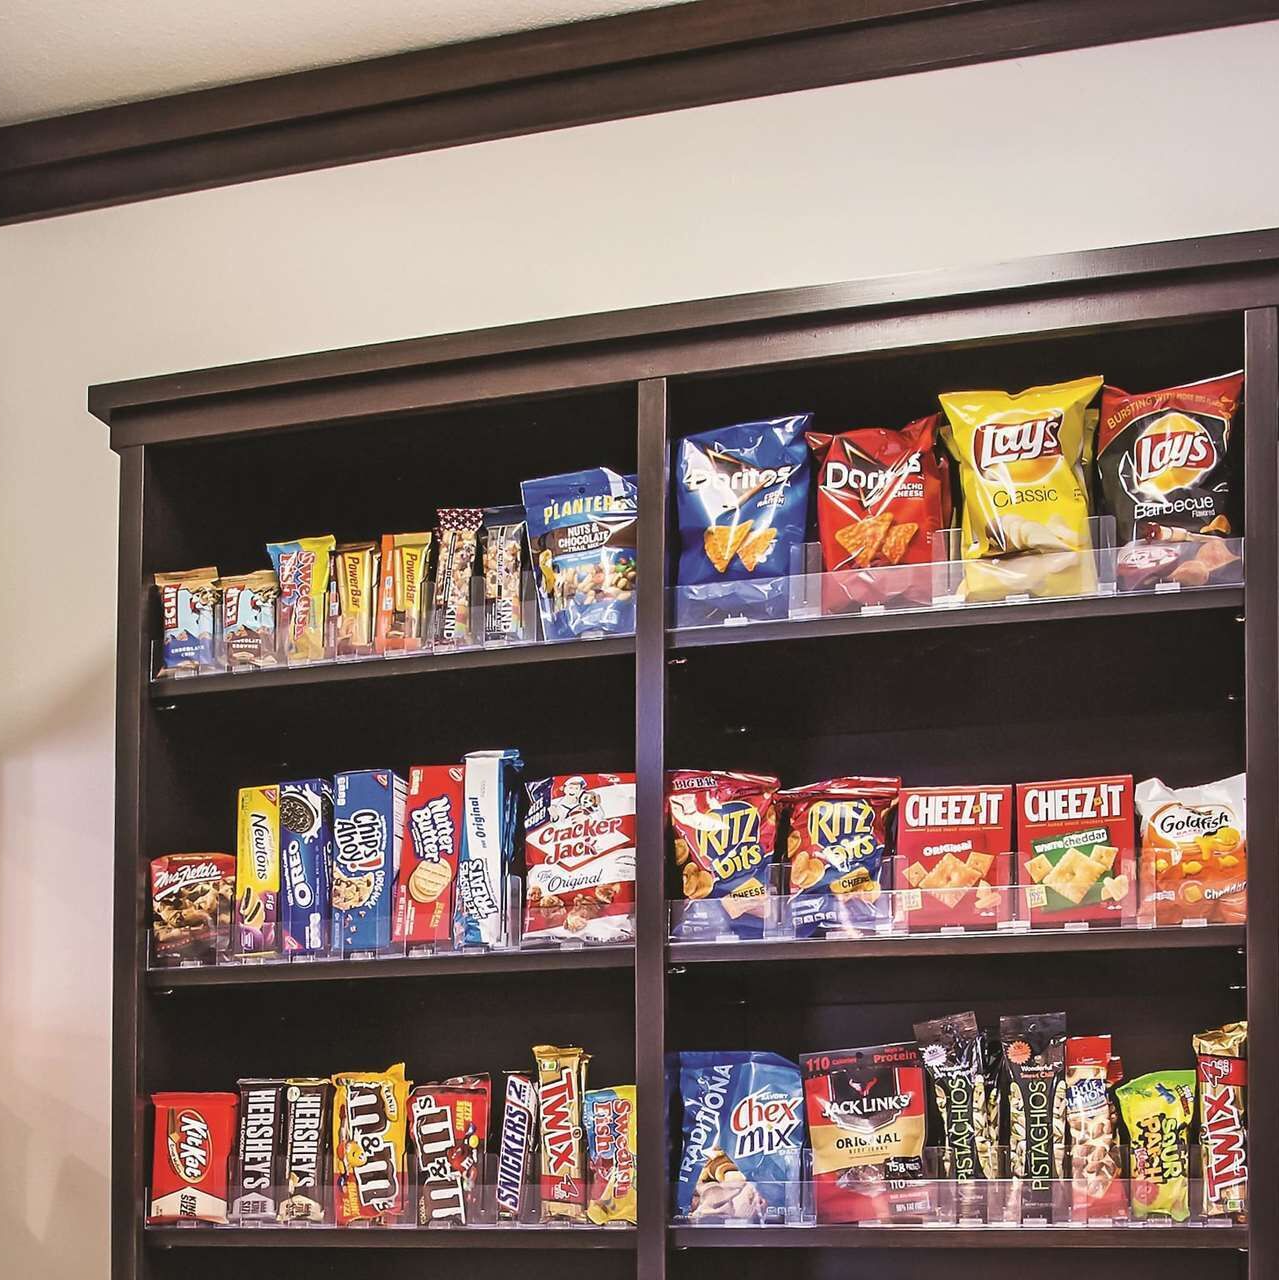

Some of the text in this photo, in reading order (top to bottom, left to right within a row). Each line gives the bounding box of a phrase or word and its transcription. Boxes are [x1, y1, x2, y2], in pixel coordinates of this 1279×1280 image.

[980, 418, 1060, 471] Lay's
[1139, 432, 1210, 482] Lay's
[689, 465, 792, 490] Doritos
[992, 485, 1059, 509] Classic
[1133, 495, 1214, 520] Barbecue
[558, 531, 609, 548] CHOCOLATE
[567, 522, 600, 538] NUTS &
[347, 556, 362, 608] PowerBar
[405, 550, 418, 605] PowerBar
[443, 605, 457, 640] KIND
[500, 599, 513, 632] KIND
[674, 776, 717, 790] BIG BAG
[352, 810, 379, 862] Chips
[411, 807, 441, 864] Butter
[428, 796, 455, 855] Nutter
[473, 796, 487, 839] Original
[537, 818, 623, 847] Cracker
[695, 806, 760, 857] RITZ
[809, 799, 874, 845] RITZ
[1160, 811, 1232, 836] Goldfish
[251, 813, 268, 881] Newtons
[545, 838, 599, 866] Jack
[711, 843, 762, 881] bits
[287, 840, 314, 909] OREO
[468, 858, 499, 920] TREATS
[547, 868, 603, 893] Original
[732, 887, 766, 900] CHEESE
[872, 1051, 918, 1064] Protein
[1071, 1080, 1099, 1095] BLUE
[540, 1069, 576, 1173] TWIX
[731, 1096, 804, 1133] Chex
[949, 1076, 971, 1185] PISTACHIOS
[242, 1087, 277, 1190] HERSHEY'S
[290, 1095, 322, 1188] HERSHEY'S
[735, 1121, 803, 1159] mix
[1029, 1080, 1050, 1191] PISTACHIOS
[1160, 1117, 1180, 1179] SOUR
[1204, 1086, 1248, 1202] TWIX
[180, 1193, 189, 1217] SIZE
[188, 1194, 197, 1217] KING
